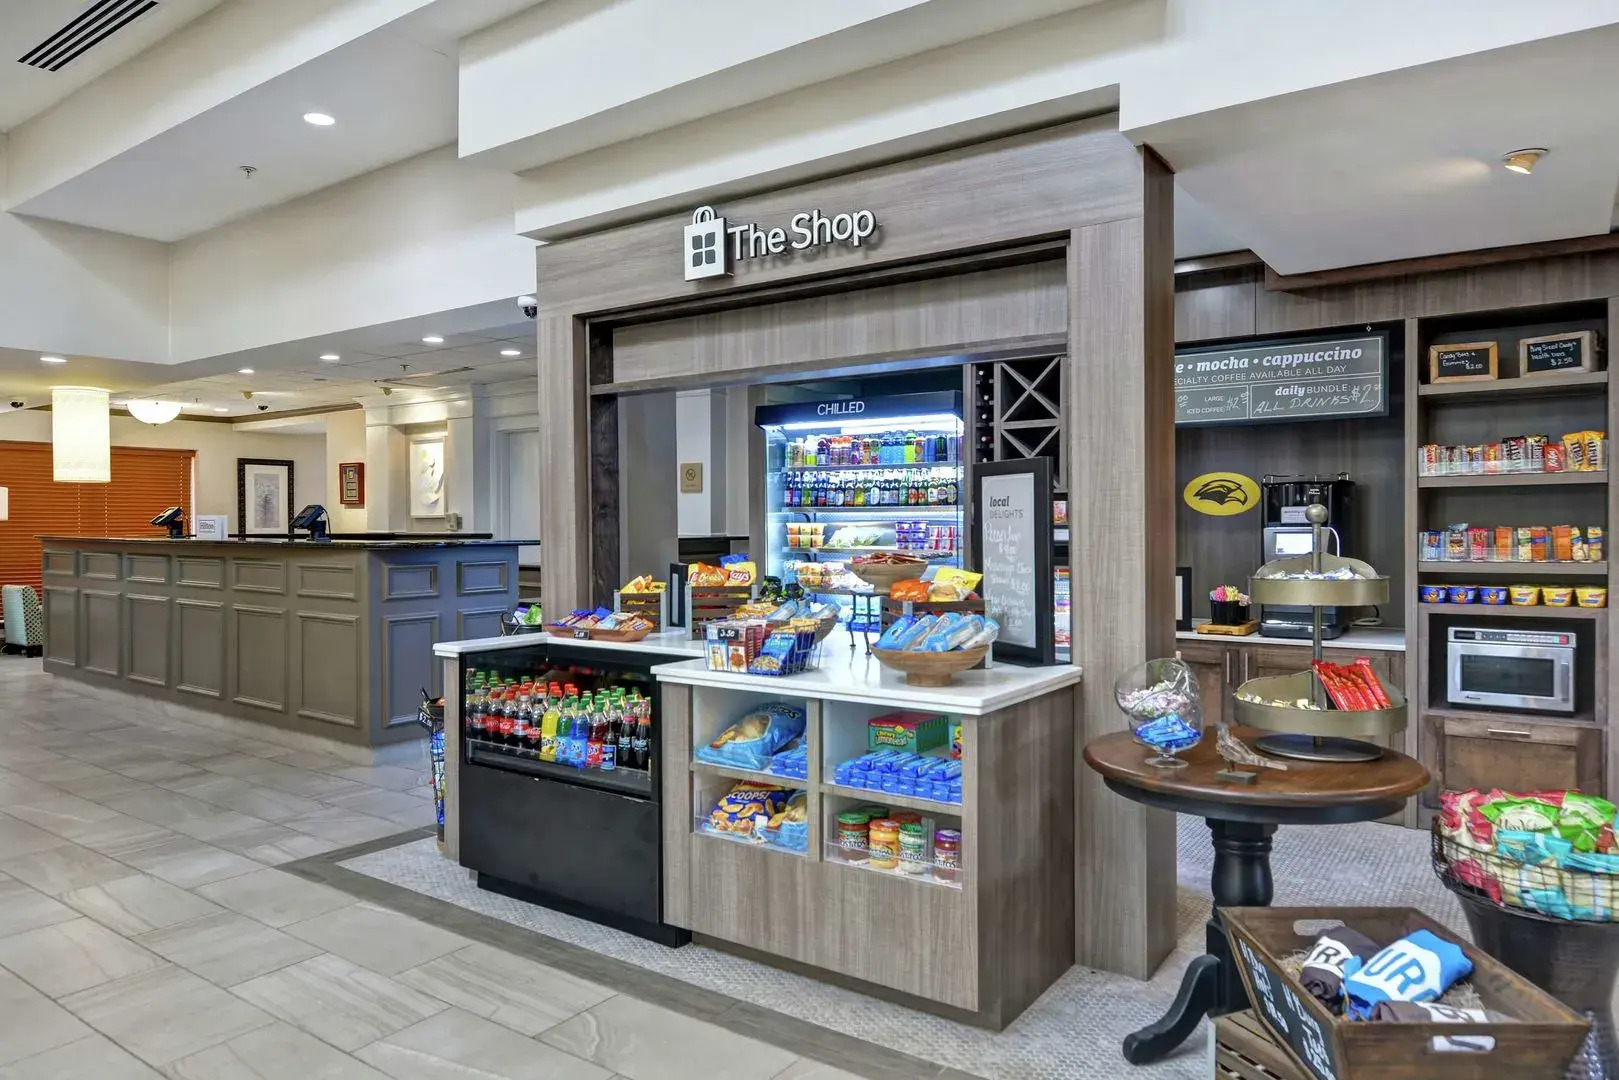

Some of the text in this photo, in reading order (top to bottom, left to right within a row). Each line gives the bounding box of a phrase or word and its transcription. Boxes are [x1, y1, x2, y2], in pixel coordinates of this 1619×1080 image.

[727, 209, 876, 260] The Shop
[1196, 356, 1249, 372] mocha
[1262, 346, 1363, 369] cappuccino
[1211, 372, 1247, 383] COFFEE
[1249, 368, 1302, 381] AVAILABLE
[1304, 366, 1324, 375] ALL
[1326, 364, 1348, 374] DAY
[1275, 385, 1306, 397] daily
[1204, 395, 1225, 403] LARGE
[1254, 394, 1350, 415] ALL DRINKS
[817, 401, 865, 416] CHILLED
[990, 495, 1010, 507] local
[989, 508, 1024, 519] DELIGHTS
